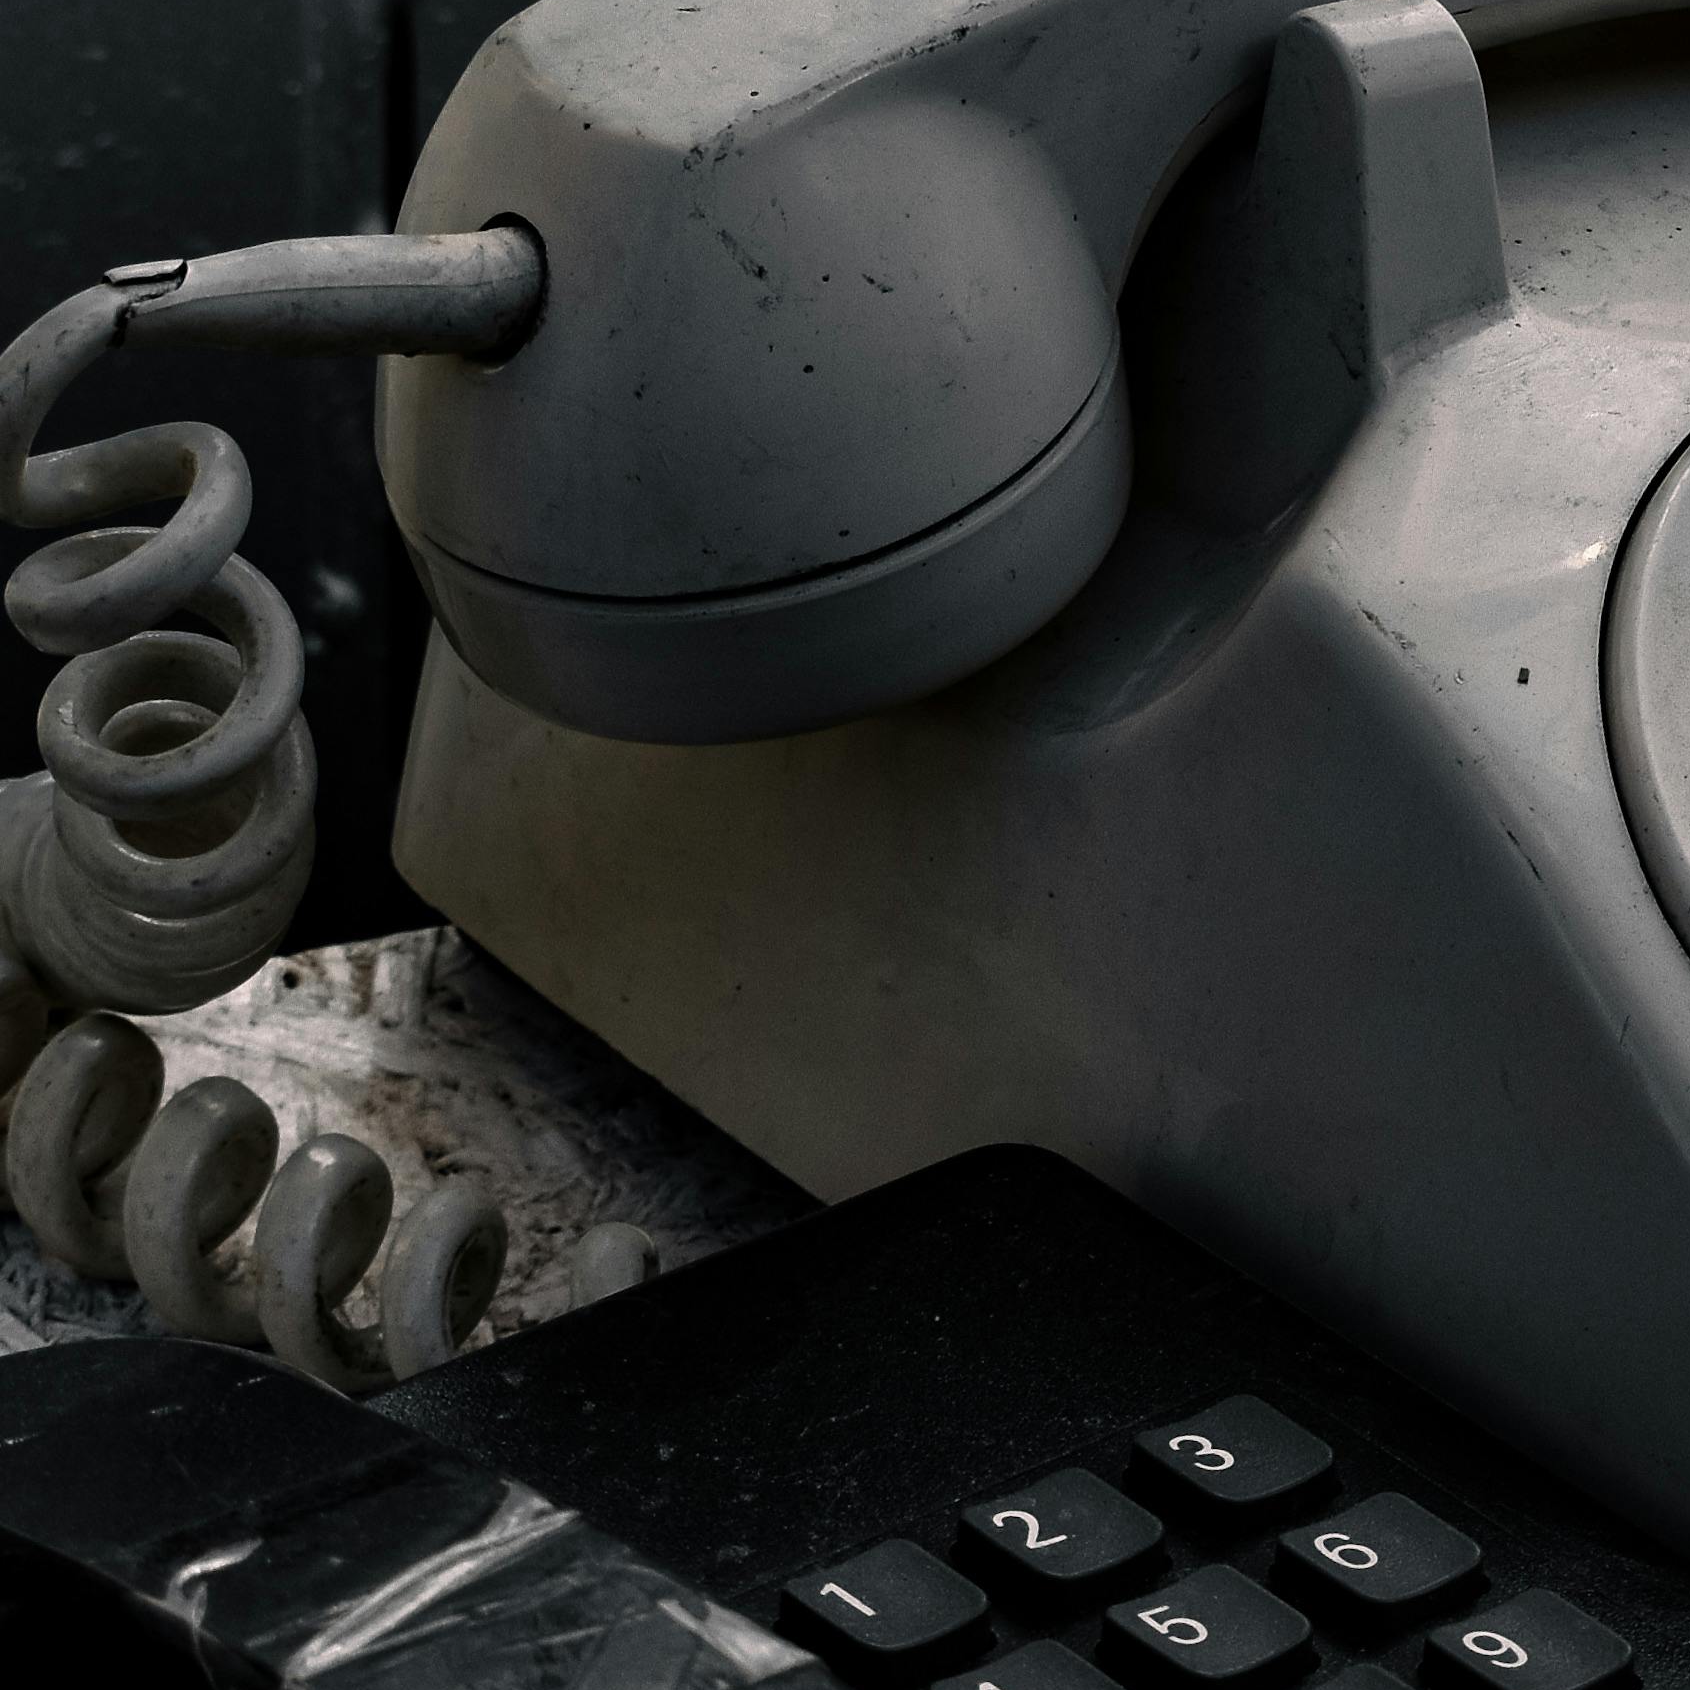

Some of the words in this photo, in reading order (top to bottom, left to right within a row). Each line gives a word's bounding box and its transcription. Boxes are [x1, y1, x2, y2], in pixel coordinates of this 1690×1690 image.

[819, 1582, 876, 1617] 1
[991, 1510, 1067, 1550] 2
[1168, 1433, 1235, 1472] 3
[1137, 1605, 1209, 1645] 5
[1313, 1531, 1379, 1570] 6
[1462, 1629, 1530, 1670] 9
